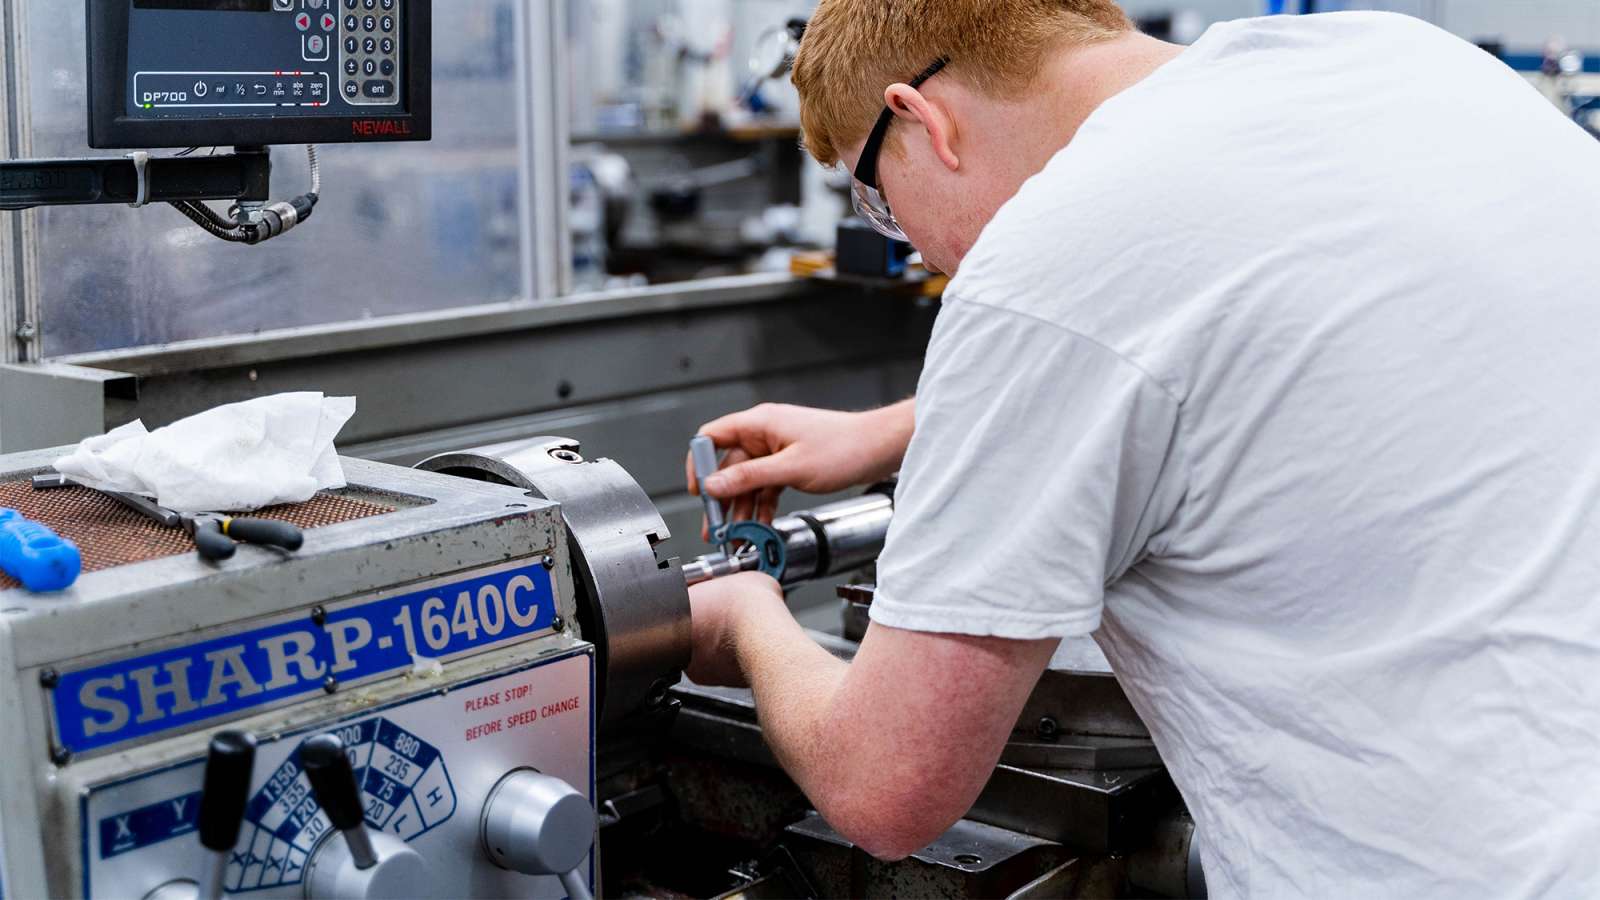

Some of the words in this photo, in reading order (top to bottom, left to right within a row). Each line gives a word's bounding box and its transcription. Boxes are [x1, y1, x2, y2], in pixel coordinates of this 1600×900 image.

[347, 18, 354, 28] 4
[366, 18, 373, 29] 5
[384, 18, 391, 29] 6
[312, 40, 319, 49] F
[349, 40, 354, 50] 1
[366, 40, 373, 51] 2
[384, 40, 391, 51] 3
[366, 62, 373, 72] 0
[143, 92, 187, 102] DP700
[216, 85, 225, 93] ref
[371, 85, 385, 93] ent
[352, 119, 411, 135] NEWALL
[79, 574, 539, 737] SHARP-1640C
[465, 693, 500, 712] PLEASE
[504, 684, 533, 702] STOP!
[465, 719, 502, 741] BEFORE
[507, 709, 537, 729] SPEED
[541, 696, 580, 718] CHANGE
[394, 733, 420, 758] 880
[384, 754, 410, 780] 235
[263, 761, 297, 801] 1350
[378, 778, 396, 801] 75
[280, 781, 306, 814] 355
[426, 786, 443, 807] H
[116, 815, 131, 839] X
[172, 798, 187, 821] Y
[290, 797, 317, 828] 120
[368, 799, 384, 820] 20
[308, 817, 324, 842] 30
